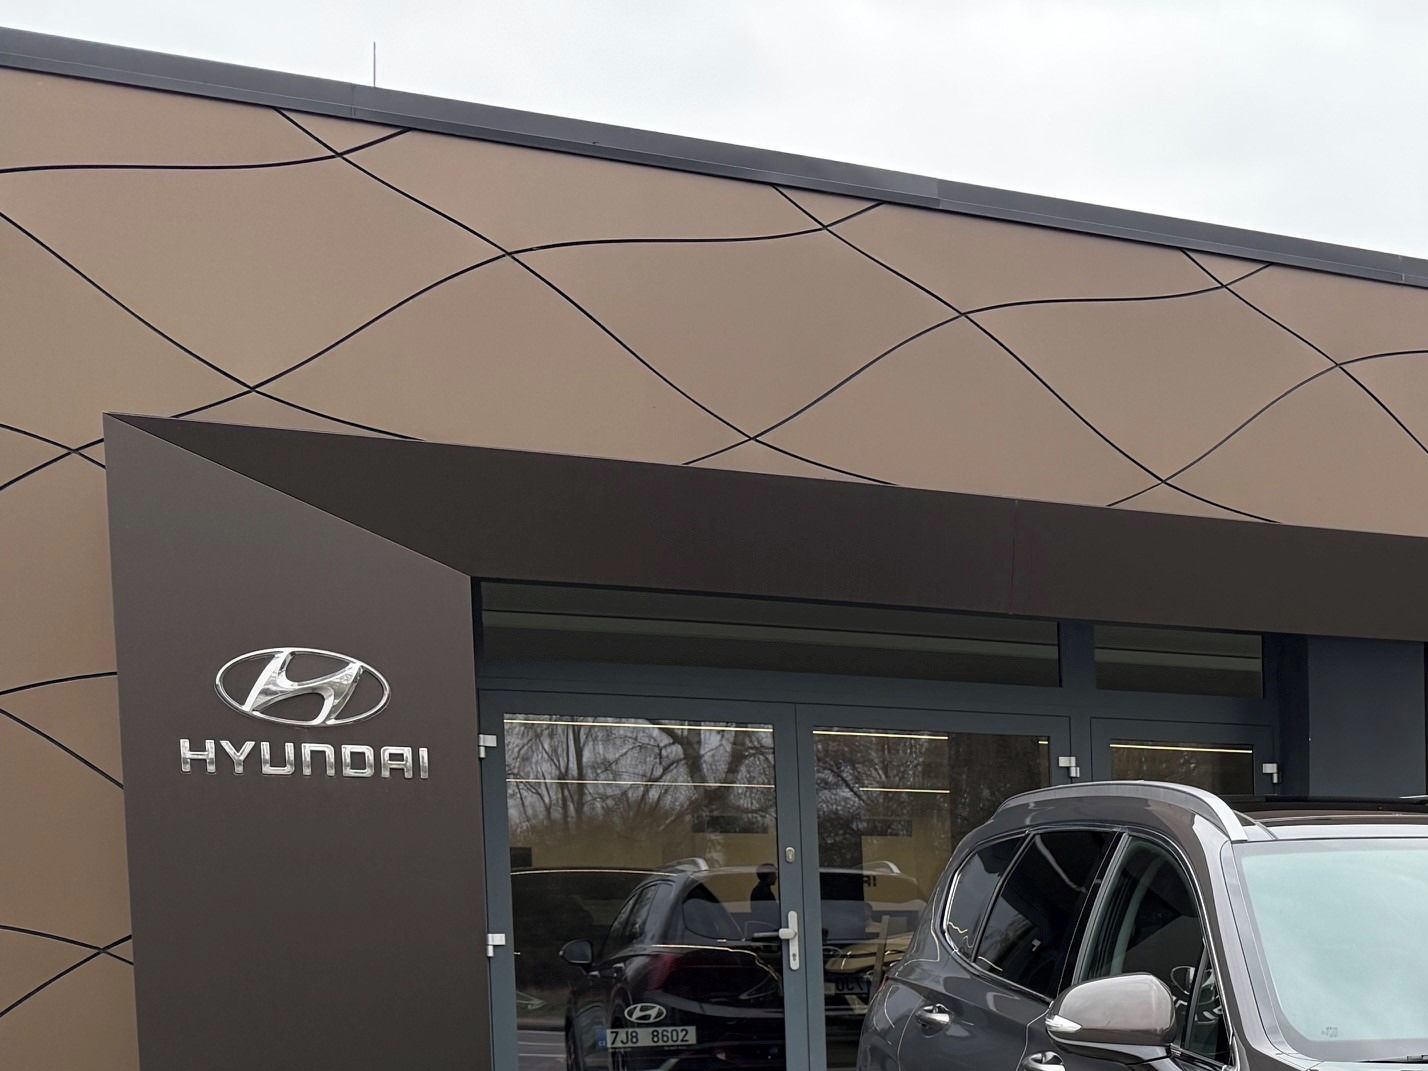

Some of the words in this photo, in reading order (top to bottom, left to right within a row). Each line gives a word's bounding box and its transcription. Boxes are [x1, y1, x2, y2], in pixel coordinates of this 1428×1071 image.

[179, 738, 430, 780] HYUNDAI
[610, 1030, 640, 1046] 7J8
[651, 1028, 690, 1044] 8602
